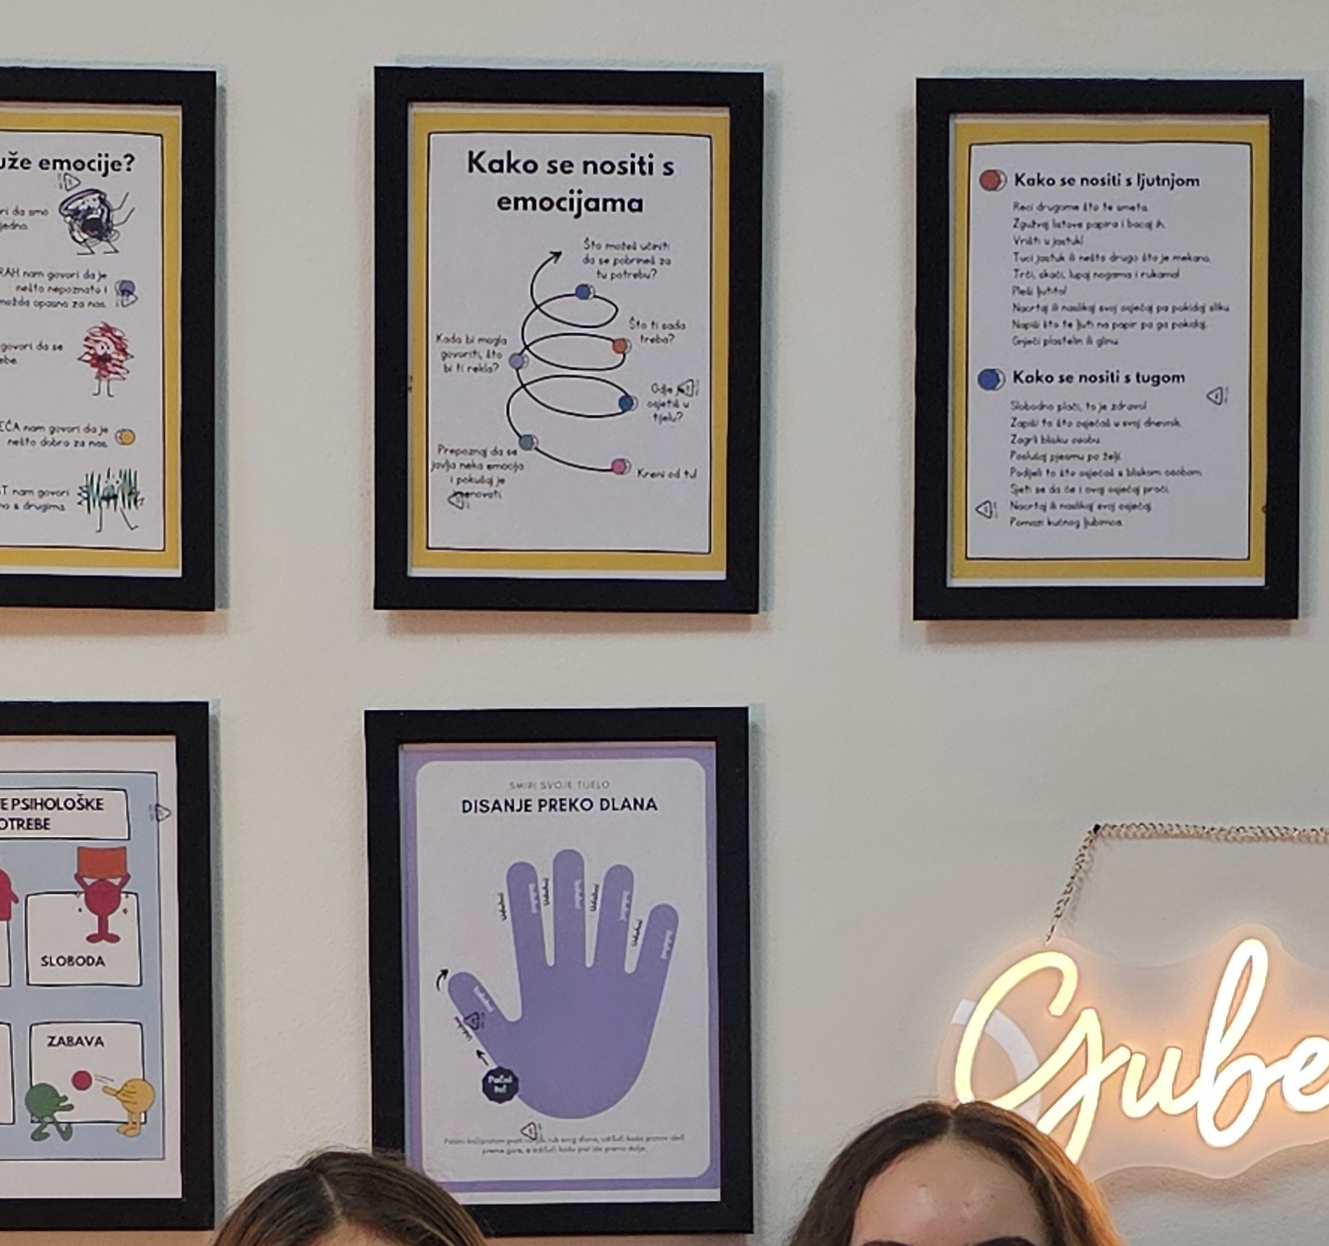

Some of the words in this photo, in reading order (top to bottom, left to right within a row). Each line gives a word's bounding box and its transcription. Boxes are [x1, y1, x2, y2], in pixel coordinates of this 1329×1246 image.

[39, 154, 135, 177] emocije?
[468, 151, 536, 174] Kako
[547, 158, 573, 174] se
[583, 154, 654, 176] nositi
[662, 161, 674, 176] s
[1015, 173, 1056, 187] Kako
[1060, 177, 1076, 187] se
[1081, 173, 1121, 187] nositi
[1126, 177, 1132, 187] s
[1138, 173, 1200, 191] ljutnjom
[497, 189, 643, 218] emocijama
[12, 205, 25, 216] da
[28, 208, 49, 216] smo
[23, 270, 43, 278] nam
[47, 271, 79, 281] govori
[83, 268, 95, 279] da
[95, 272, 107, 282] je
[597, 269, 607, 279] tu
[611, 268, 657, 280] potrebu?
[640, 334, 675, 344] treba?
[1, 343, 33, 352] govori
[36, 340, 49, 351] da
[444, 364, 452, 373] bi
[457, 364, 465, 372] ti
[467, 363, 499, 373] rekla?
[1013, 370, 1054, 383] Kako
[1058, 373, 1074, 383] se
[1079, 370, 1120, 384] nositi
[1124, 374, 1131, 384] s
[1136, 372, 1185, 386] tugom
[49, 425, 80, 435] govori
[84, 423, 96, 433] da
[97, 426, 109, 436] je
[438, 444, 487, 458] Prepoznaj
[490, 446, 503, 456] da
[638, 468, 665, 478] Kreni
[668, 468, 680, 479] od
[12, 488, 34, 496] nam
[37, 489, 70, 498] govori
[12, 793, 104, 811] PSIHOLOŠKE
[462, 799, 532, 813] DISANJE
[538, 798, 594, 812] PREKO
[600, 798, 658, 811] DLANA
[41, 956, 105, 967] SLOBODA
[47, 1036, 104, 1048] ZABAVA
